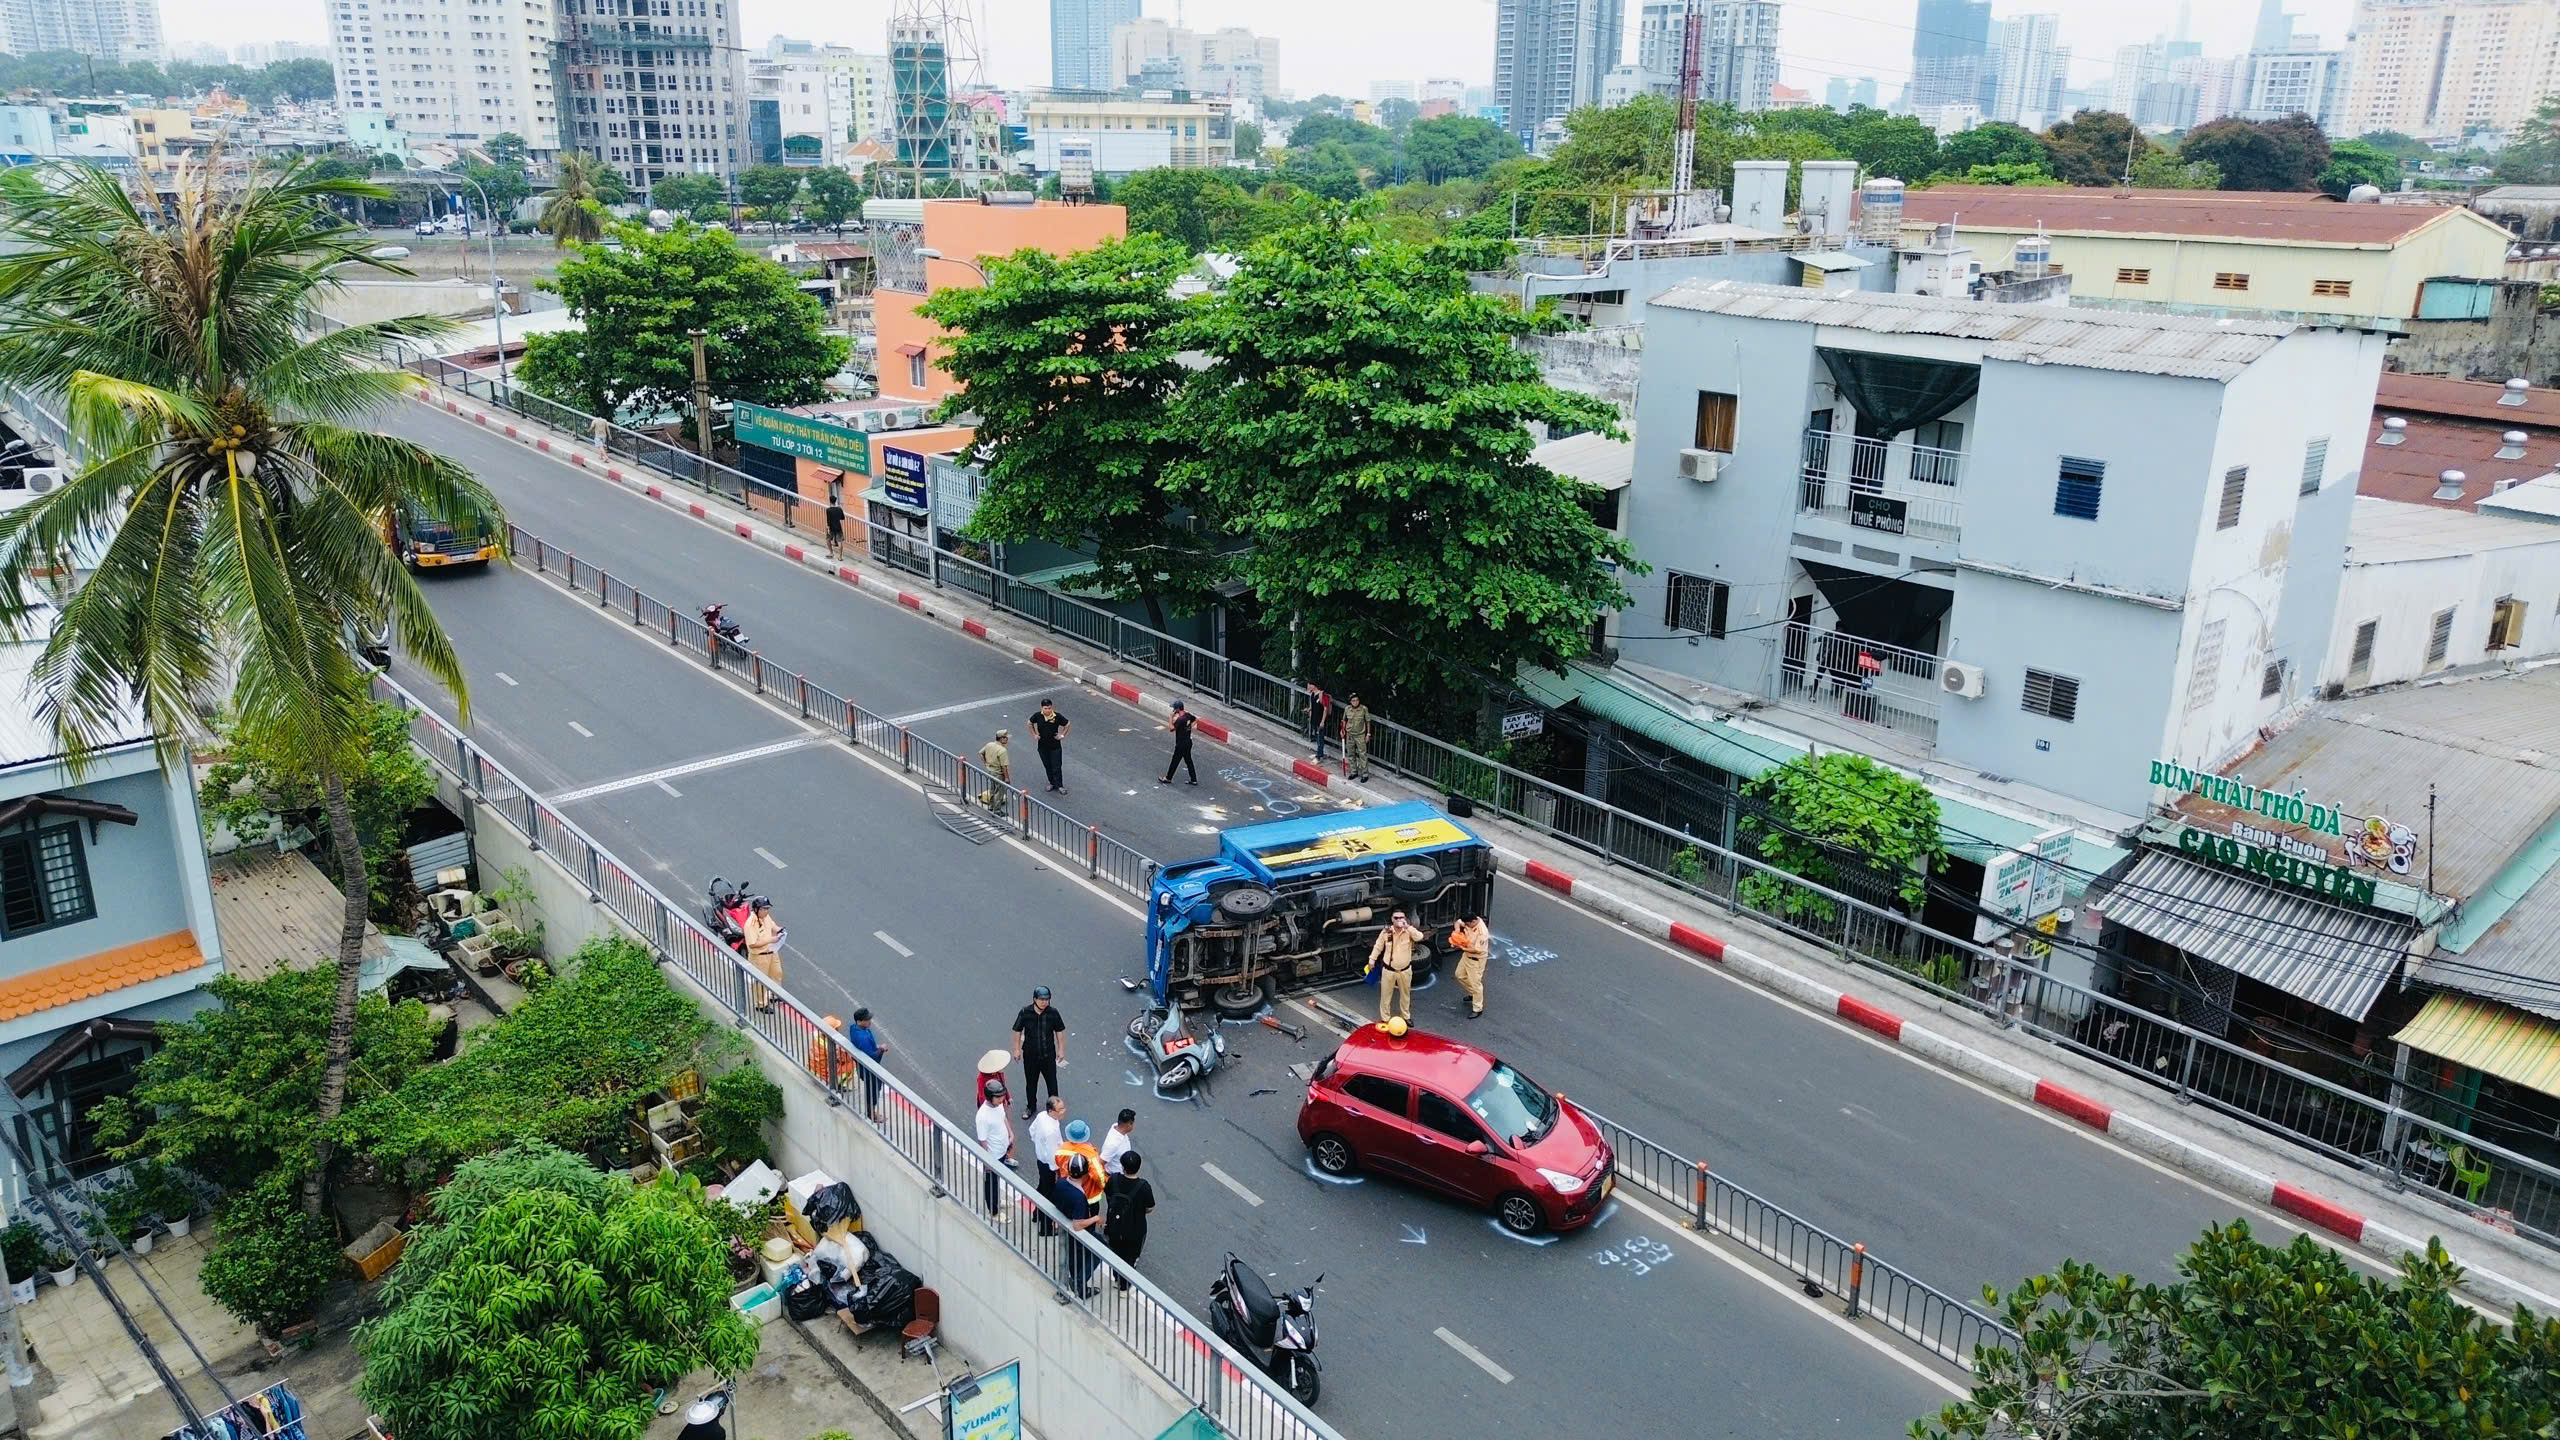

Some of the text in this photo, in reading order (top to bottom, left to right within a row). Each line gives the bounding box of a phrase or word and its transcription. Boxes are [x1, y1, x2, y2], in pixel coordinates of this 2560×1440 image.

[796, 442, 802, 453] 3
[814, 447, 825, 459] 12
[1868, 499, 1891, 512] CHO
[1853, 511, 1904, 533] THUÊ PHÒNG
[2199, 773, 2257, 812] THÁI
[2259, 788, 2308, 825] THỐ
[2308, 801, 2344, 836] ĐÁ
[2179, 826, 2377, 906] CAO NGUYÊN
[961, 1403, 1010, 1433] YUMMY
